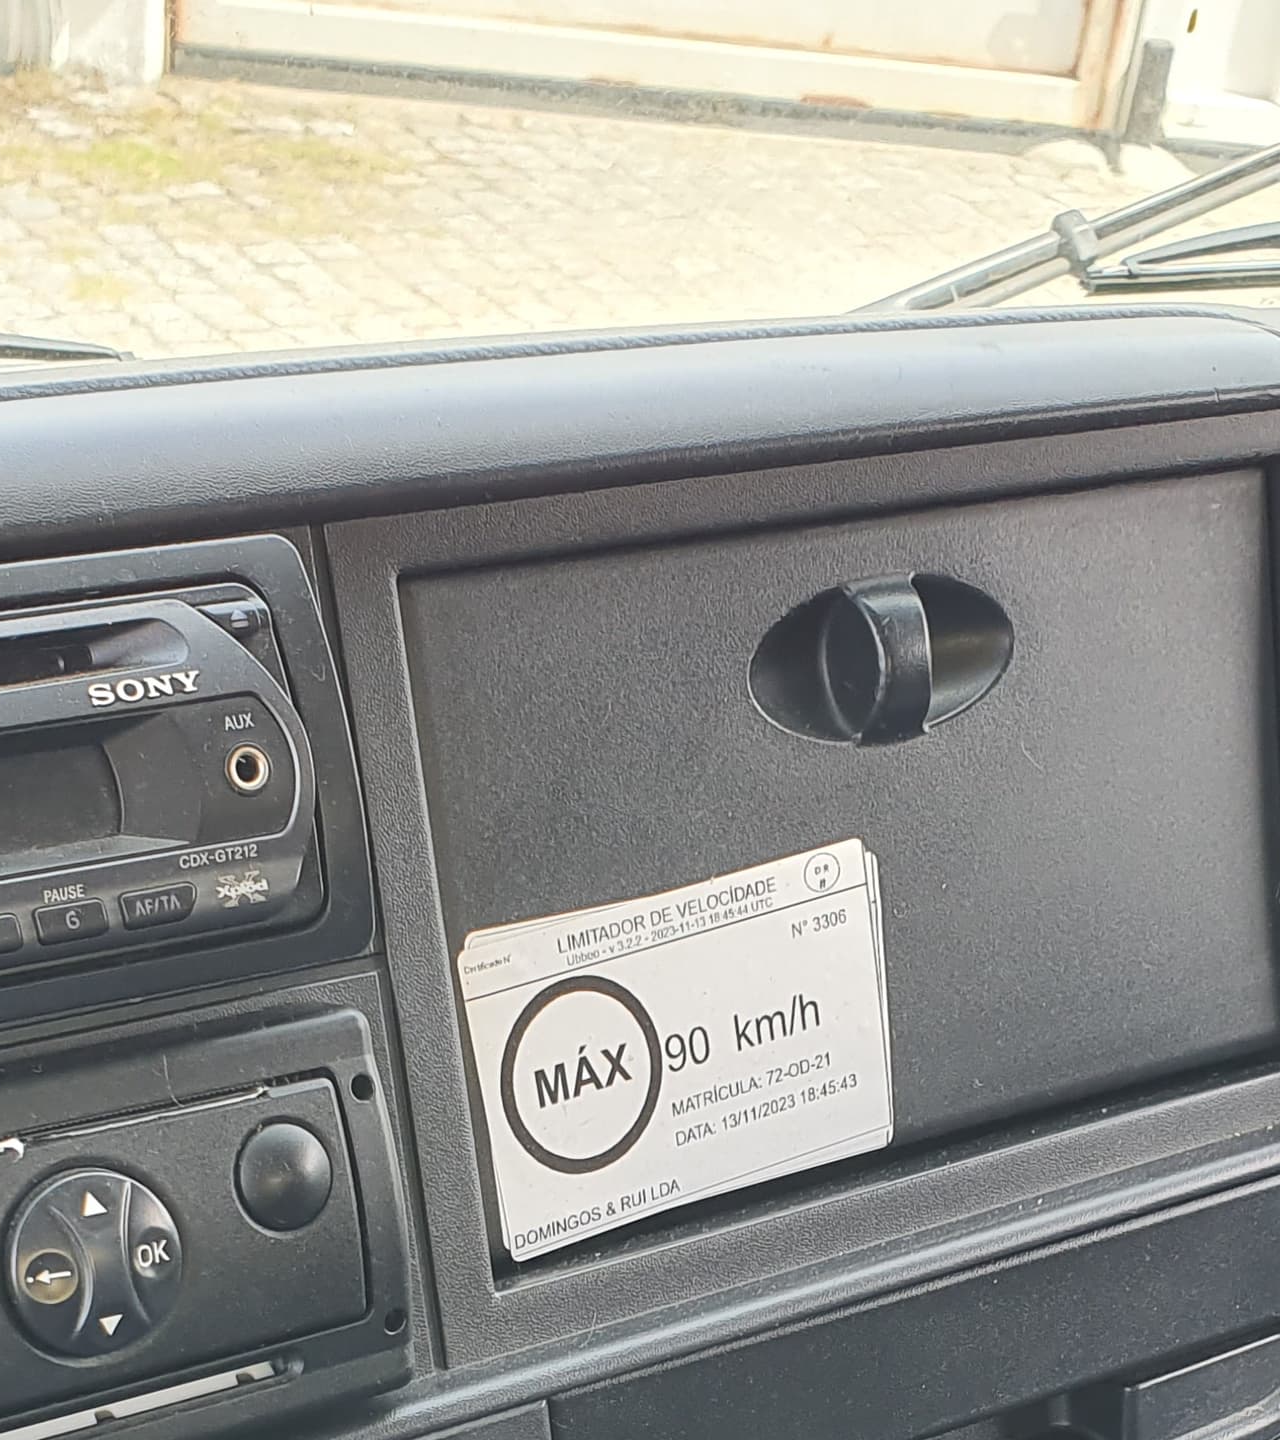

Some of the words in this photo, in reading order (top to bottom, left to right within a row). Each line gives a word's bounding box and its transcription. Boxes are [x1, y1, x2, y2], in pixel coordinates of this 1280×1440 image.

[88, 670, 200, 707] SONY
[224, 713, 254, 731] AUX
[179, 844, 258, 870] CDX-GT212
[43, 884, 85, 903] PAUSE
[65, 910, 81, 929] 6
[557, 915, 645, 954] LIMITADOR
[650, 906, 673, 927] DE
[651, 916, 706, 943] 2023-11-13
[751, 897, 774, 913] UTC
[812, 908, 847, 933] 3306
[665, 1026, 710, 1072] 90
[733, 993, 821, 1051] km/h
[534, 1043, 633, 1109] MÁX
[672, 1076, 762, 1117] MATRÍCULA:
[766, 1051, 831, 1086] 72-OD-21
[675, 1121, 717, 1147] DATA:
[721, 1093, 796, 1130] 13/11/2023
[801, 1073, 858, 1105] 18:45:43
[514, 1207, 602, 1250] DOMINGOS
[606, 1201, 616, 1217] &
[620, 1189, 647, 1212] RUI
[650, 1179, 681, 1201] LDA
[137, 1239, 170, 1268] OK
